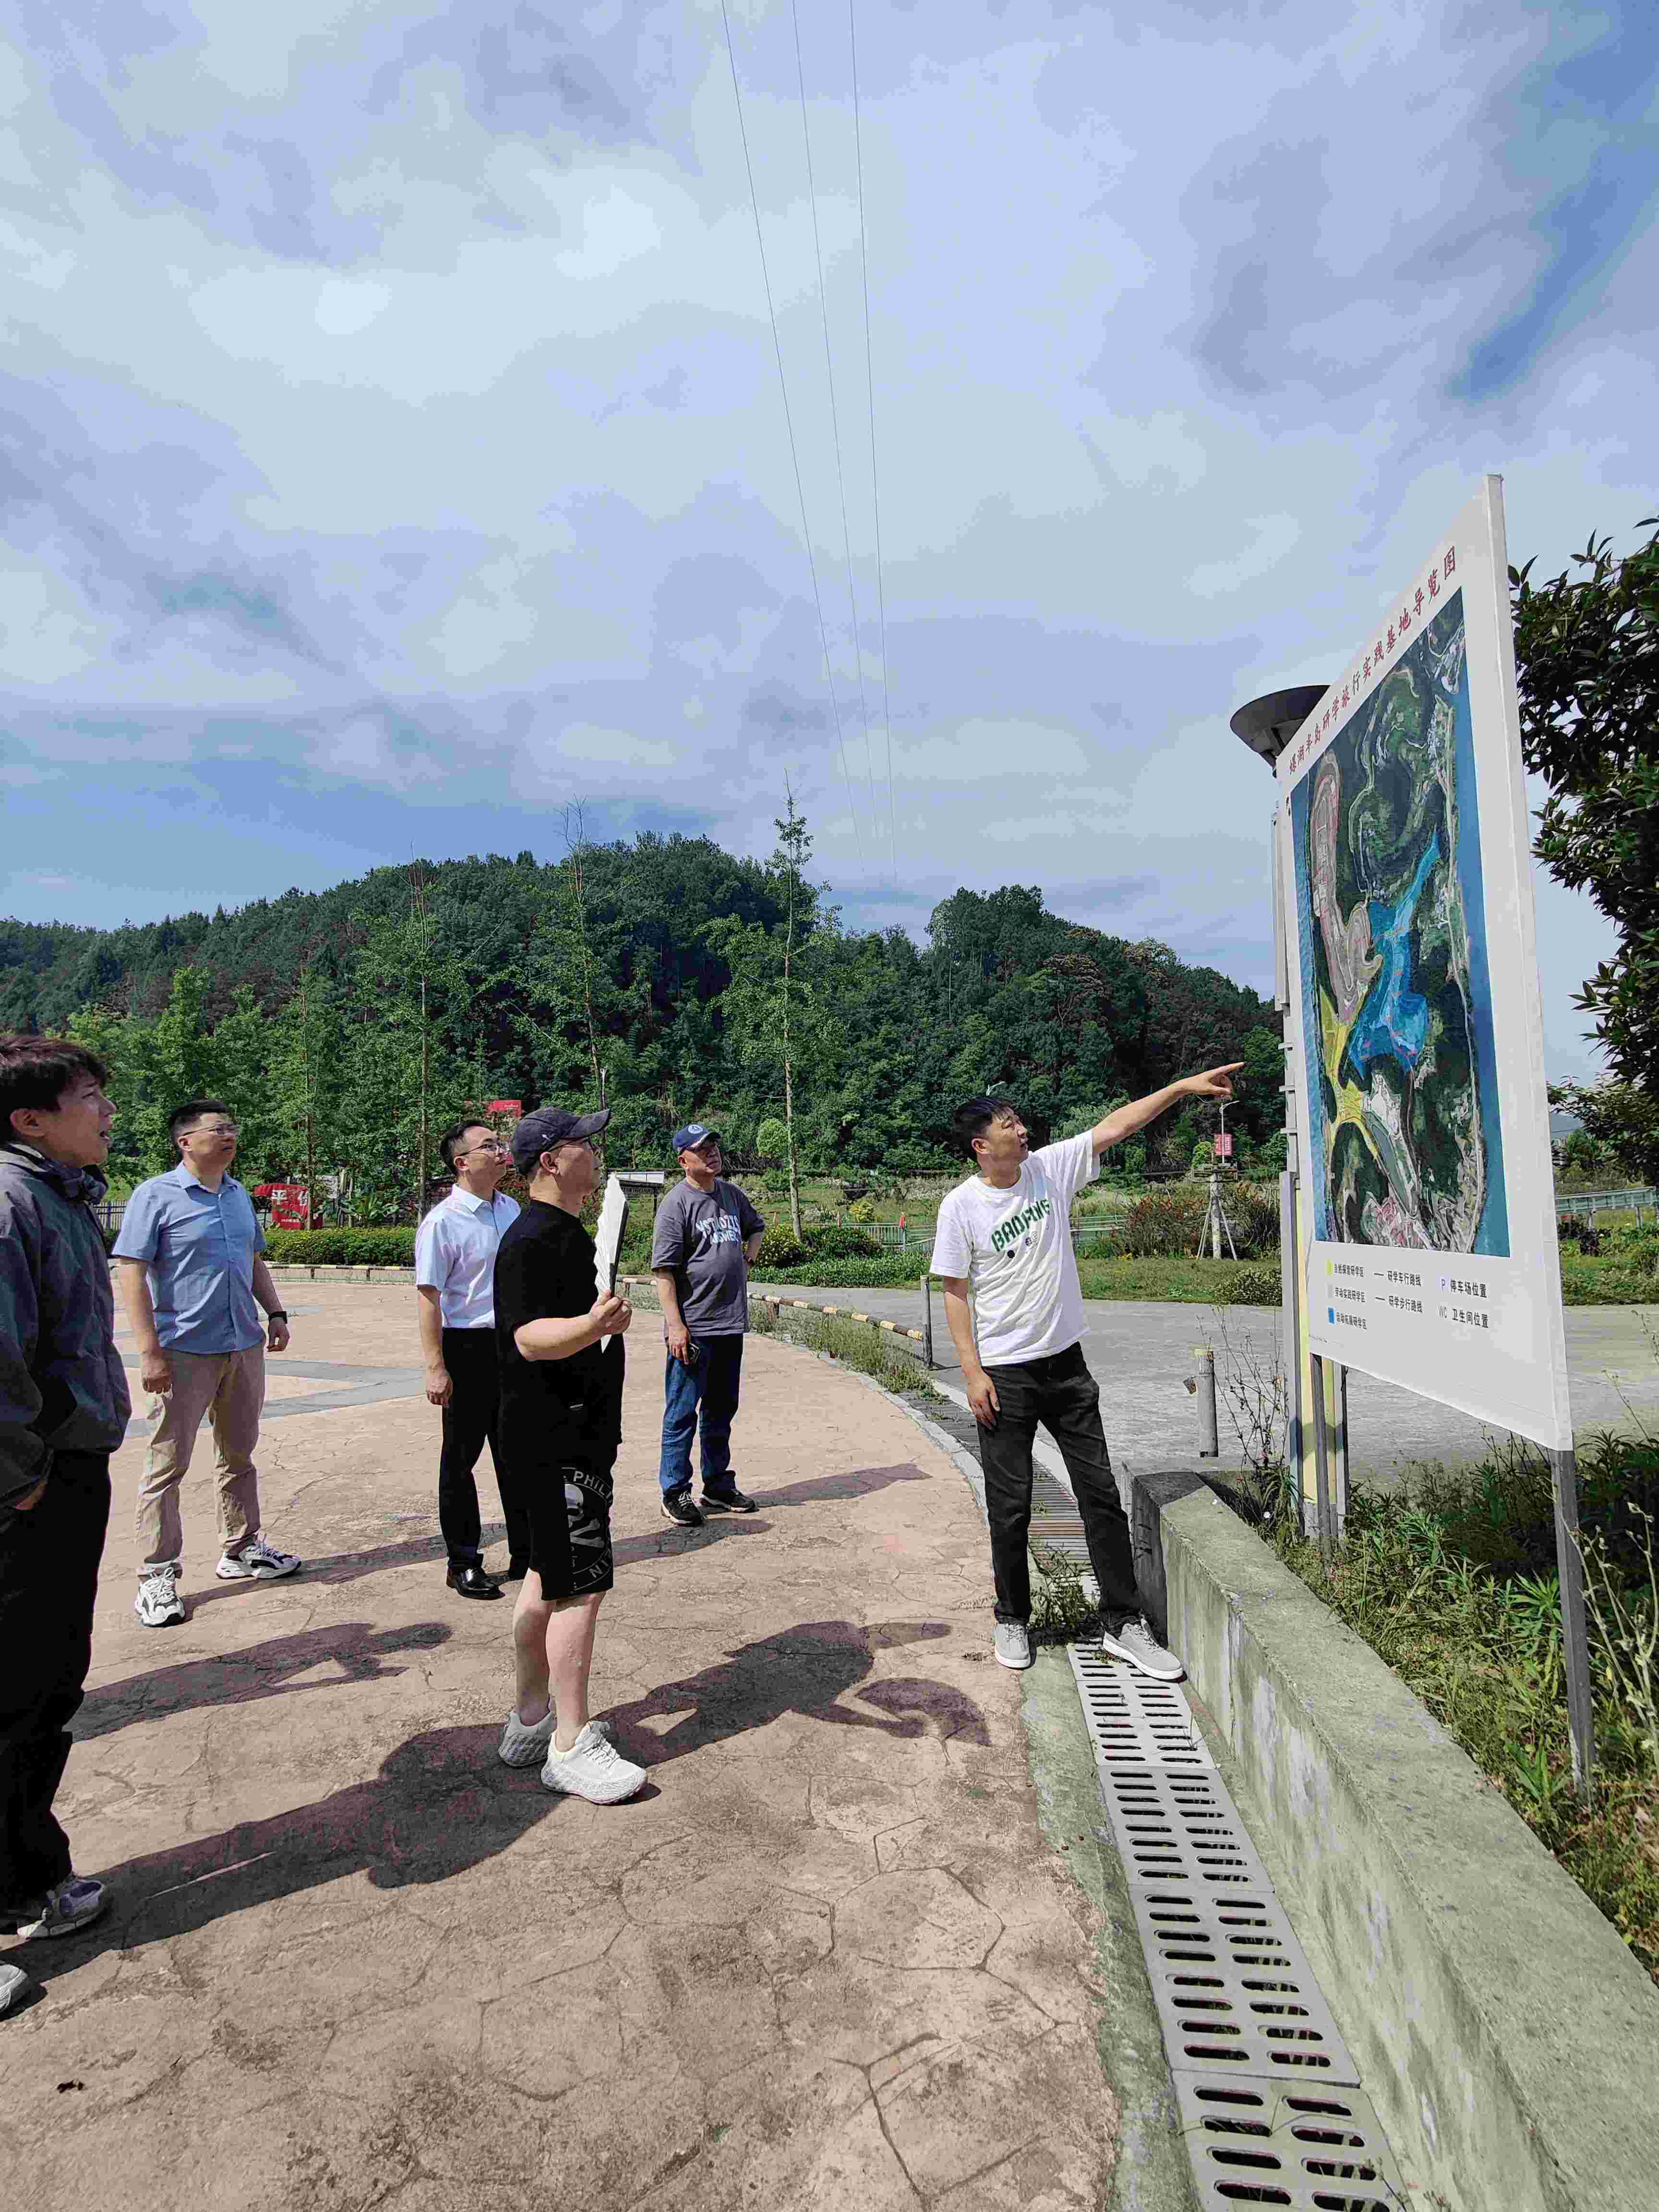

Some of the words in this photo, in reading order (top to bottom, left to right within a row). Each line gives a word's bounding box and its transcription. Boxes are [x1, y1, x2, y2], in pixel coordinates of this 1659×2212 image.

[1387, 1271, 1421, 1286] 研学车行路线
[1450, 1279, 1487, 1298] 停车场位置
[1388, 1295, 1422, 1313] 研学步行路线
[1439, 1306, 1447, 1318] WC
[1452, 1308, 1489, 1328] 卫生间位置
